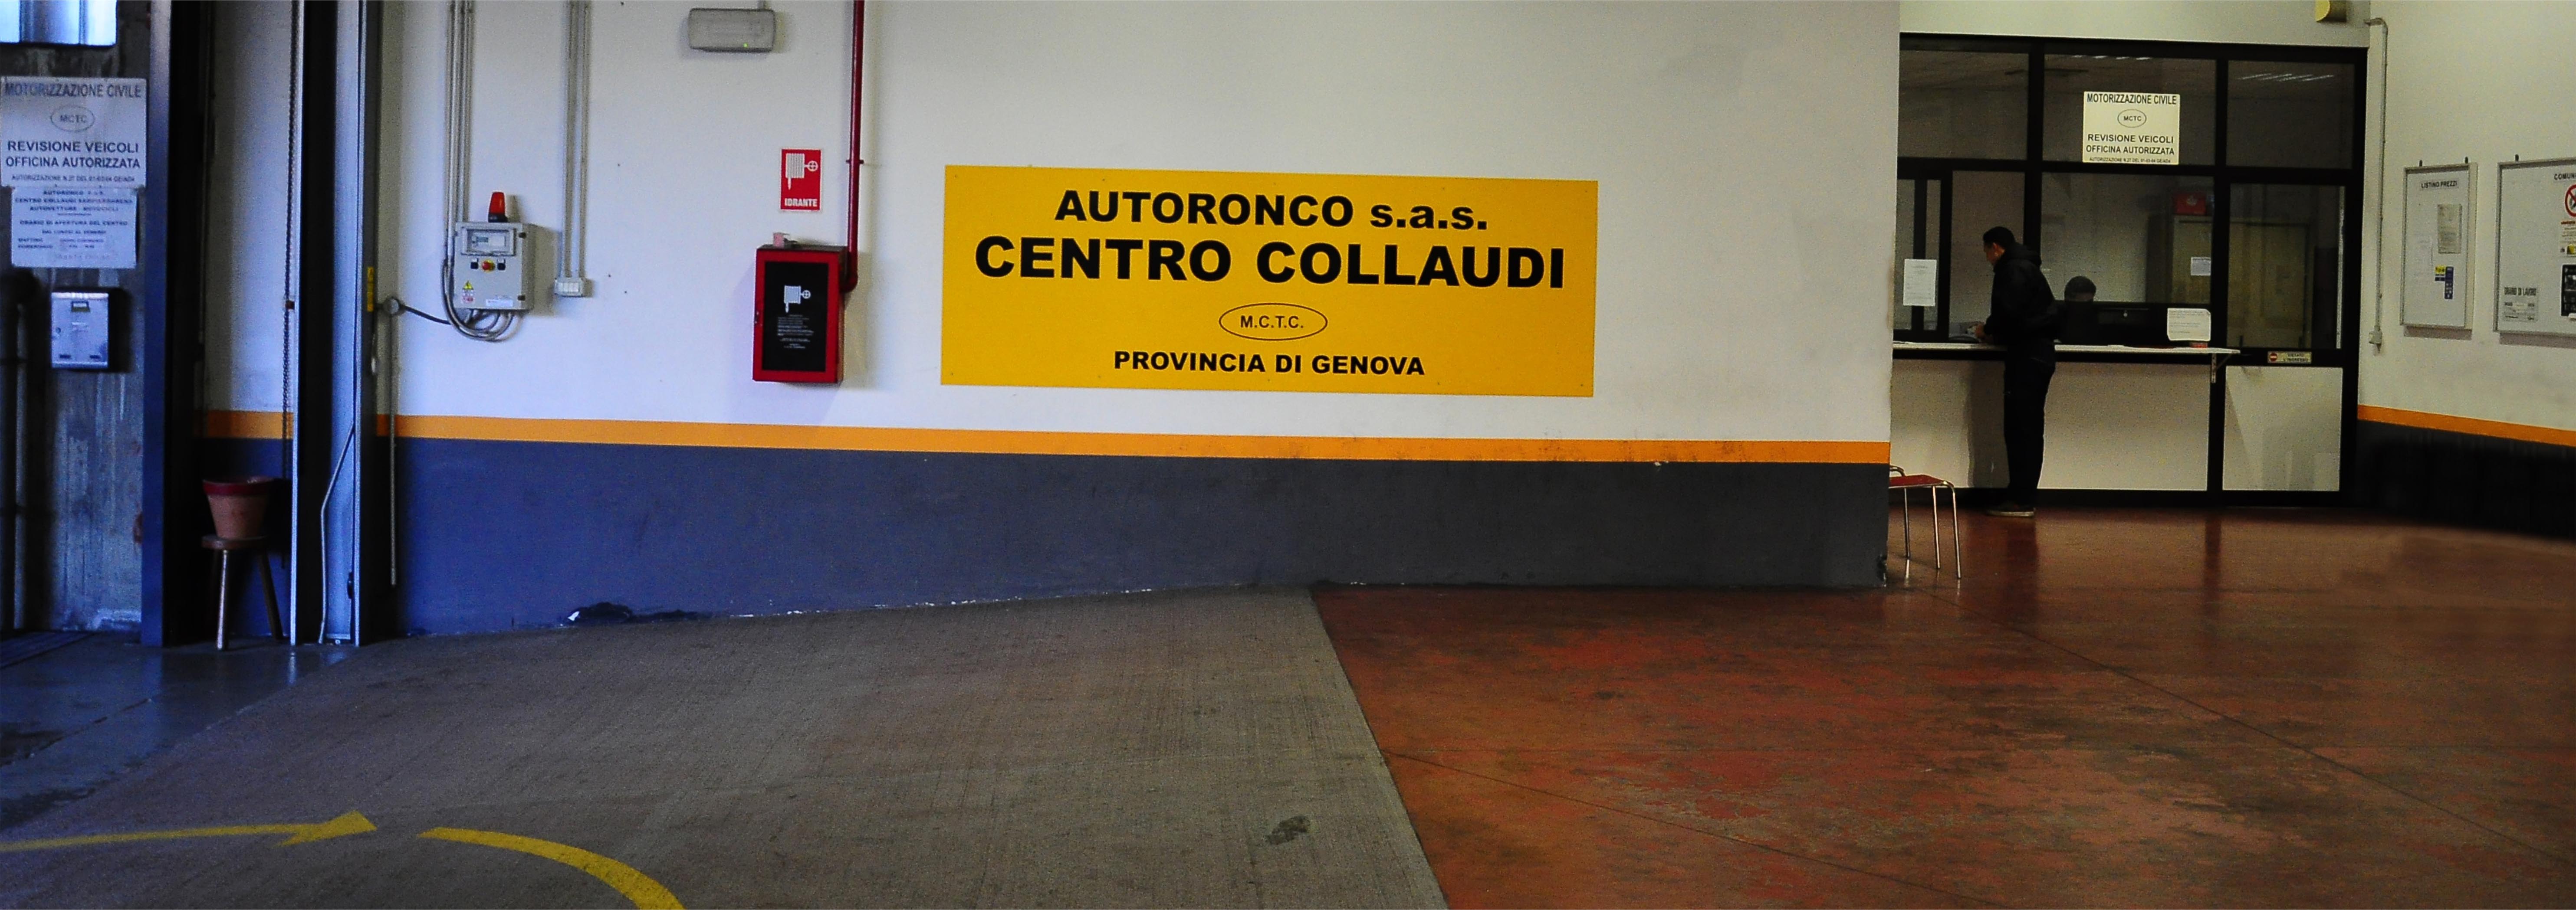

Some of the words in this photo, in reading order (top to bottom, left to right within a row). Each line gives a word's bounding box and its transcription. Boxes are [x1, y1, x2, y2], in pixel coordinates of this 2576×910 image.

[5, 82, 103, 98] MOTORIZZAZIONE
[106, 85, 141, 98] CIVILE
[2087, 93, 2152, 104] MOTORIZZAZIONE
[2154, 95, 2177, 105] CIVILE
[59, 115, 87, 123] MCTC
[2088, 134, 2136, 142] REVISIONE
[2139, 135, 2174, 144] VEICOLI
[7, 140, 81, 152] REVISIONE
[85, 141, 138, 153] VEICOLI
[2086, 145, 2121, 153] OFFICINA
[2123, 146, 2175, 155] AUTORIZZATA
[6, 156, 59, 167] OFFICINA
[62, 157, 140, 169] AUTORIZZATA
[784, 198, 818, 207] IDRANTE
[1055, 190, 1353, 227] AUTORONCO
[1370, 204, 1487, 230] s.a.s.
[976, 236, 1231, 282] CENTRO
[1257, 242, 1564, 288] COLLAUDI
[1240, 315, 1304, 328] M.C.T.C.
[1114, 351, 1265, 372] PROVINCIA
[1276, 354, 1301, 373] DI
[1312, 355, 1424, 375] GENOVA
